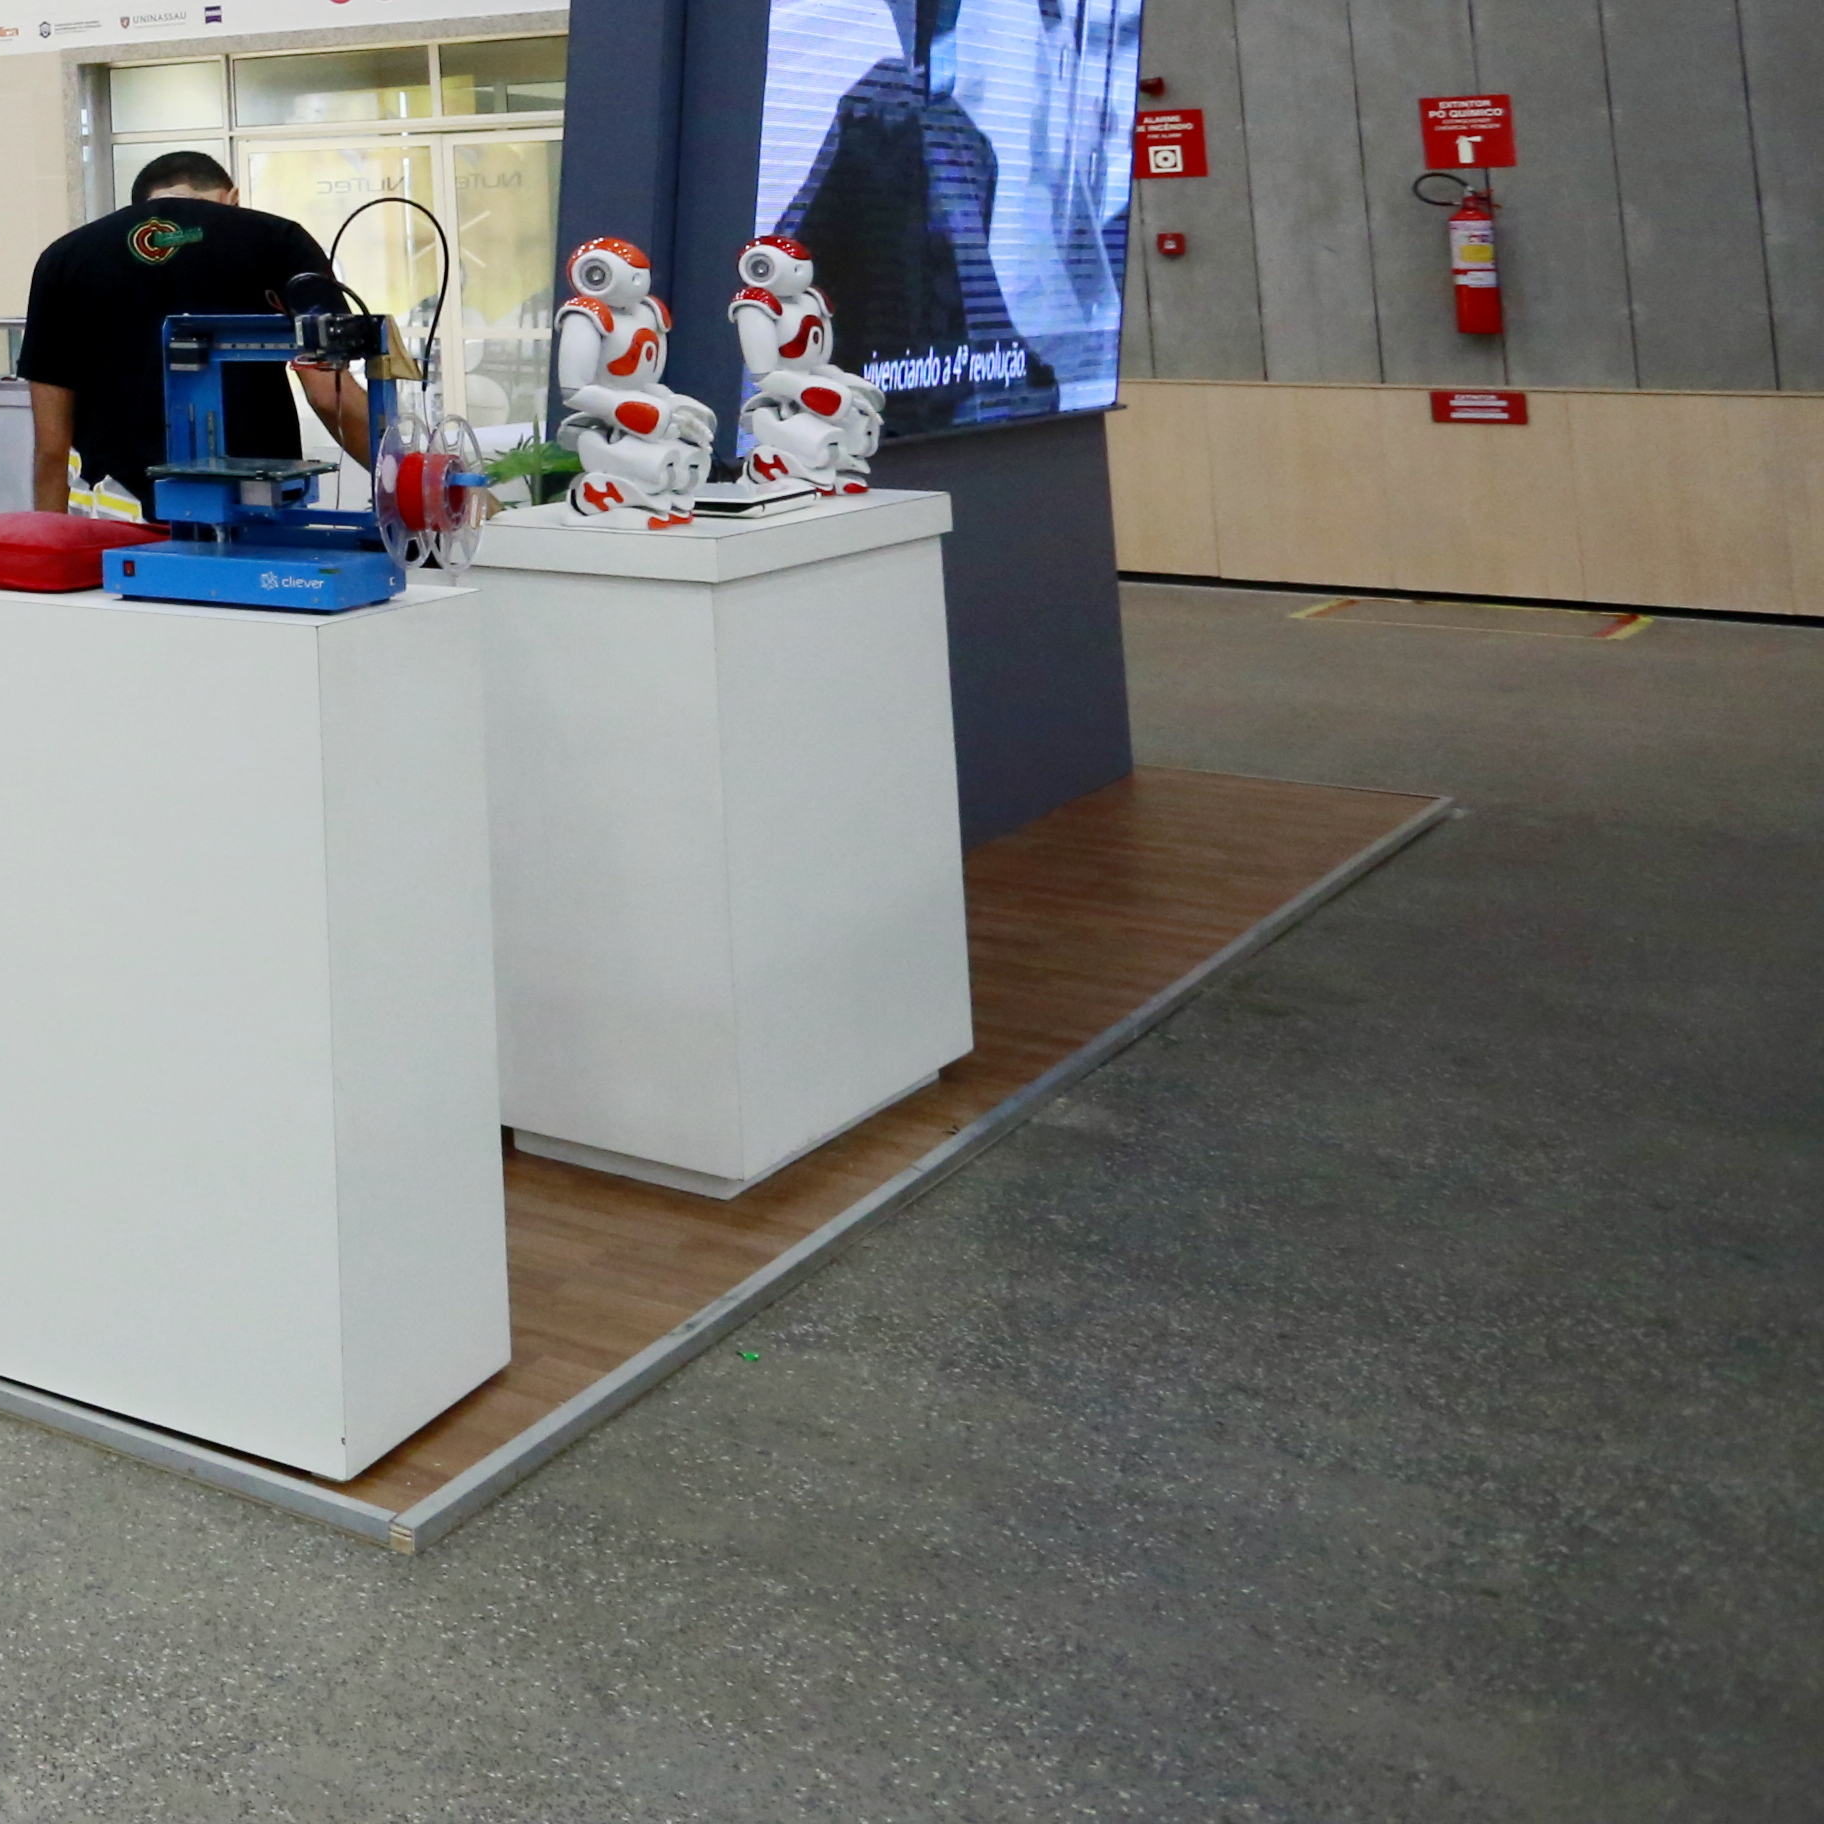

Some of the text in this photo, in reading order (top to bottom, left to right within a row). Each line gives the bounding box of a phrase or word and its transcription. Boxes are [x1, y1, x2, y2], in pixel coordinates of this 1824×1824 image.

[132, 12, 187, 24] UNINASSAU
[864, 346, 941, 392] vivenciando
[942, 355, 951, 385] a
[281, 577, 324, 589] cliever
